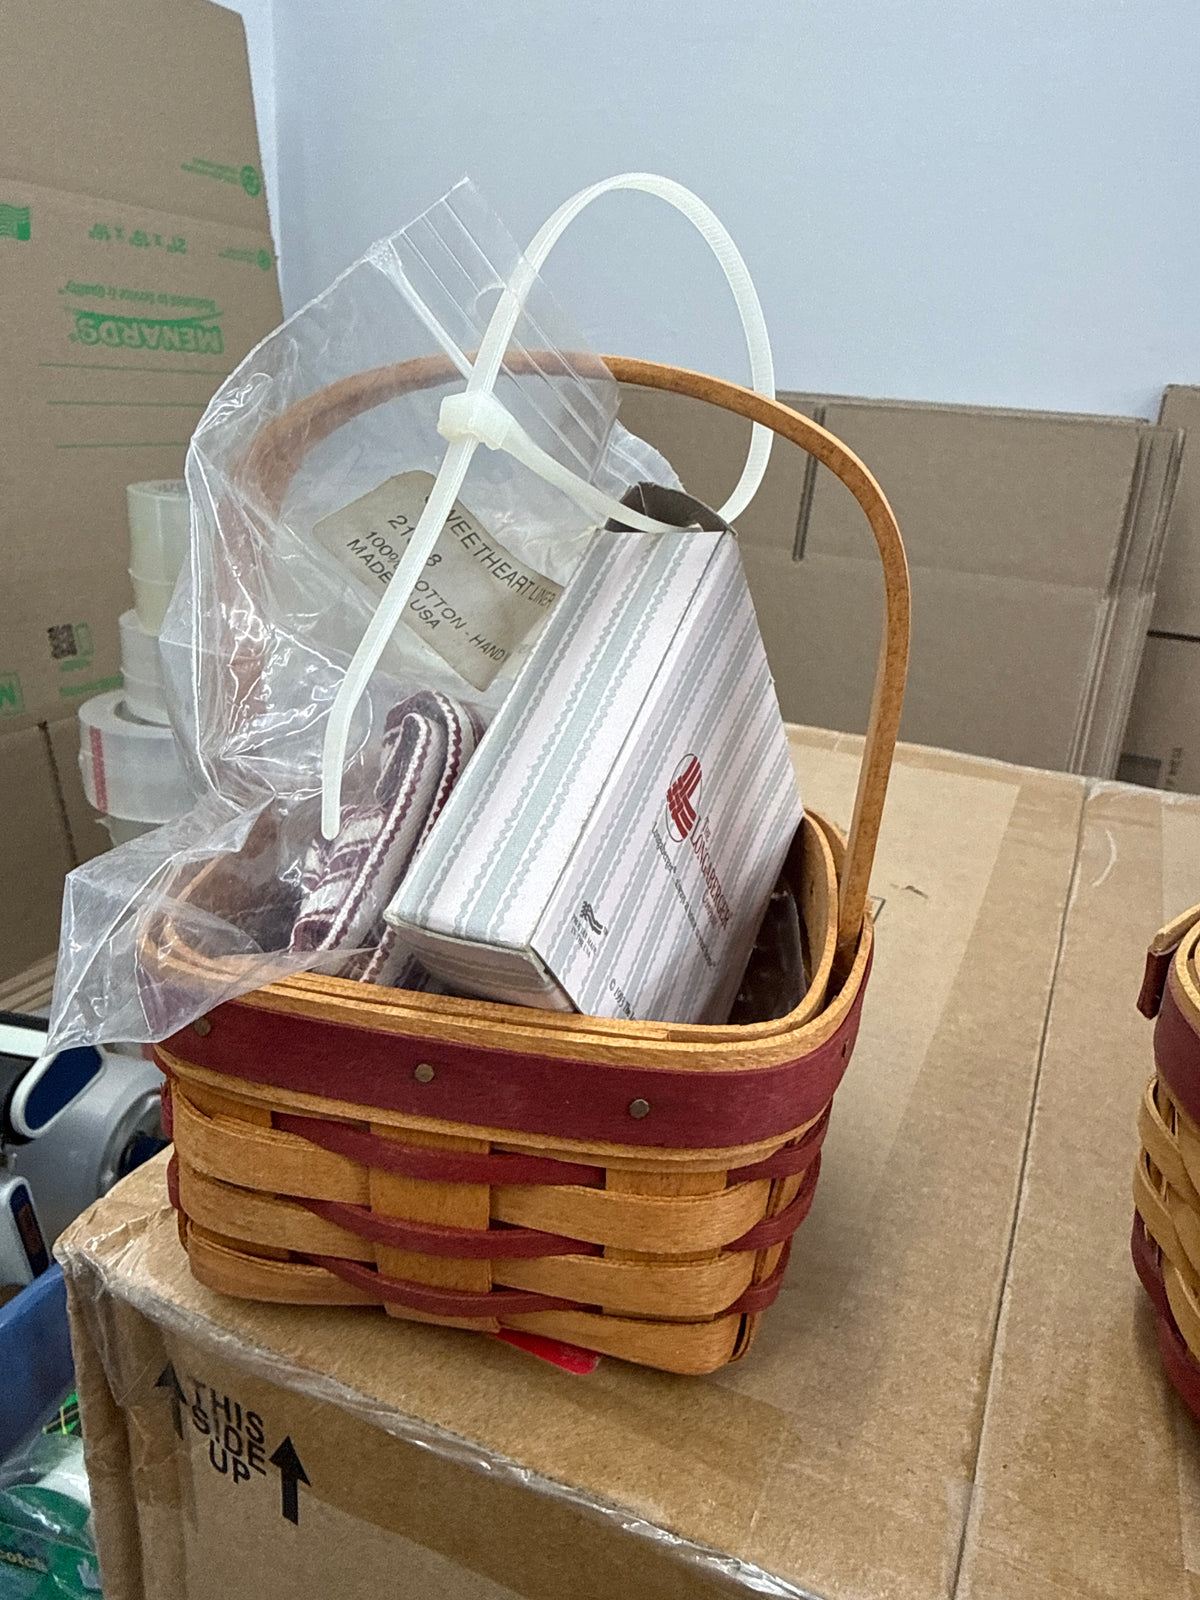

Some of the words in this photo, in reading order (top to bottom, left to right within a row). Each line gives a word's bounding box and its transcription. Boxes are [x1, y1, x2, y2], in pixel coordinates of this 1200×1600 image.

[76, 317, 224, 355] MENARDS
[387, 514, 442, 567] 218
[425, 495, 536, 596] EETHEART
[346, 538, 393, 584] MADE
[409, 599, 441, 629] USA
[411, 580, 467, 630] OTTON
[186, 1375, 264, 1445] THIS
[192, 1404, 267, 1476] SIDE
[209, 1439, 250, 1484] UP
